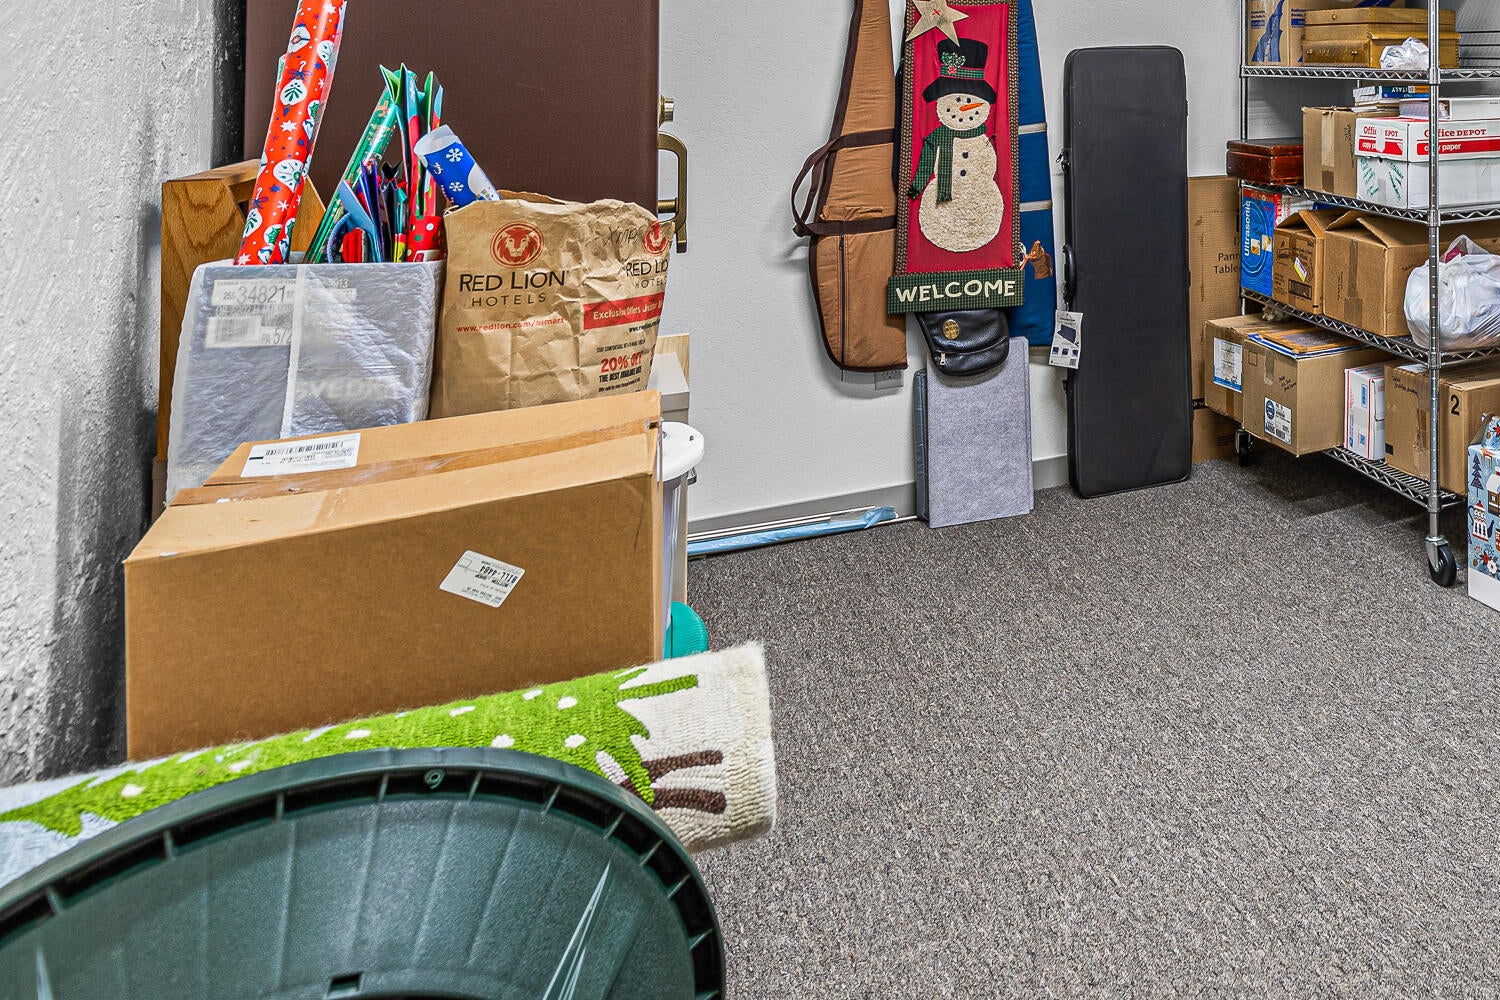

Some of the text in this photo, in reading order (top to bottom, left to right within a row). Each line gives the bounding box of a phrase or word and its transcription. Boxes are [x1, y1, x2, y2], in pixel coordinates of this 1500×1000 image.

[1424, 128, 1487, 138] Ofice DEPOT
[1442, 142, 1462, 153] paper
[1243, 200, 1251, 257] Ultrasonic
[626, 259, 669, 277] RED LIO
[1213, 265, 1239, 275] Table
[459, 270, 565, 292] RED LION
[634, 276, 667, 288] HOTELS
[236, 285, 286, 305] 34821
[471, 292, 546, 308] HOTELS
[895, 279, 1016, 303] WELCOME
[600, 350, 644, 373] 20% OFF
[599, 374, 609, 383] THE
[609, 371, 620, 381] BEST
[1450, 393, 1460, 416] 2
